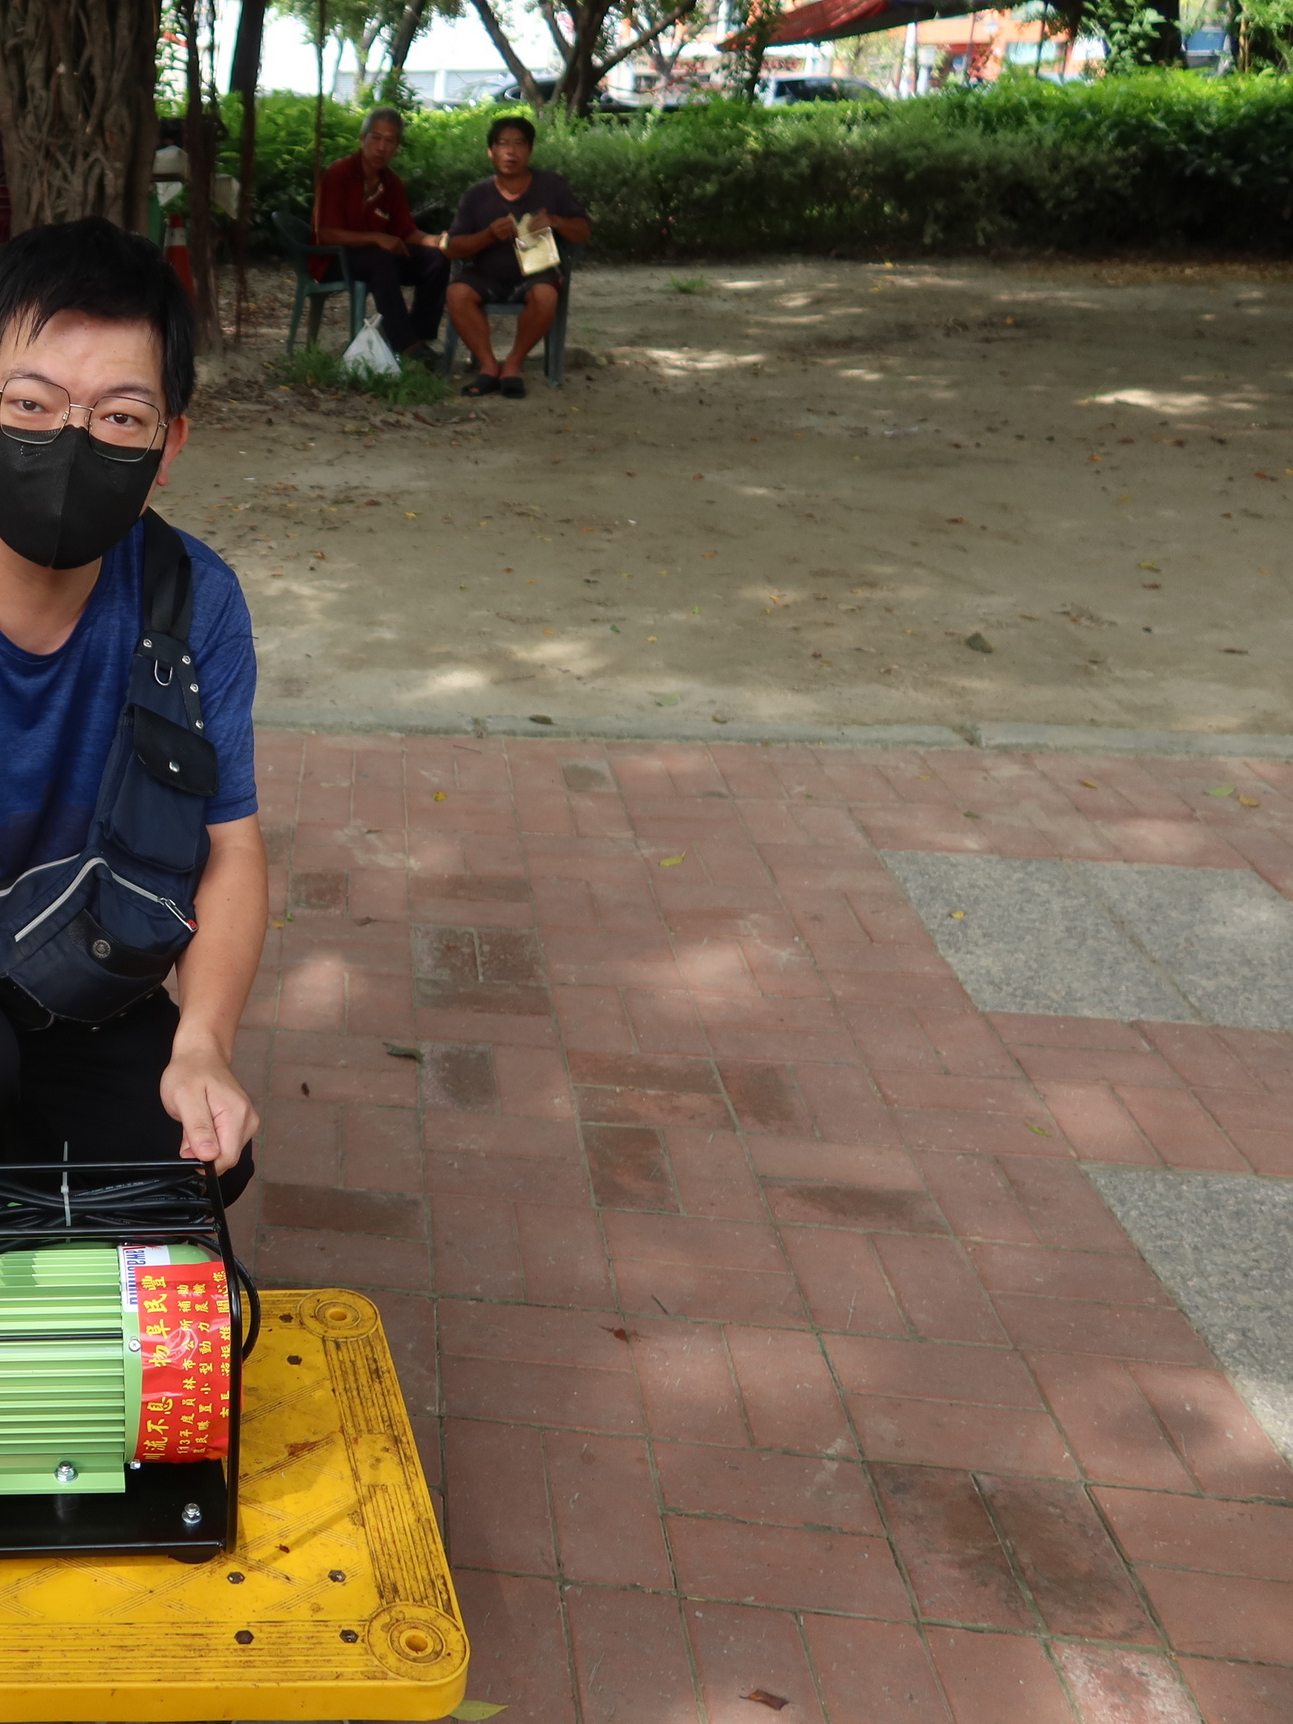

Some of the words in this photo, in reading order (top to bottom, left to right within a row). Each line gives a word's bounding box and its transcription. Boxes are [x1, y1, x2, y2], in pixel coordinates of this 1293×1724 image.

[141, 1275, 172, 1367] 物阜民豐
[177, 1284, 197, 1455] 113年度員林市公所補助
[141, 1396, 173, 1460] 川流不息
